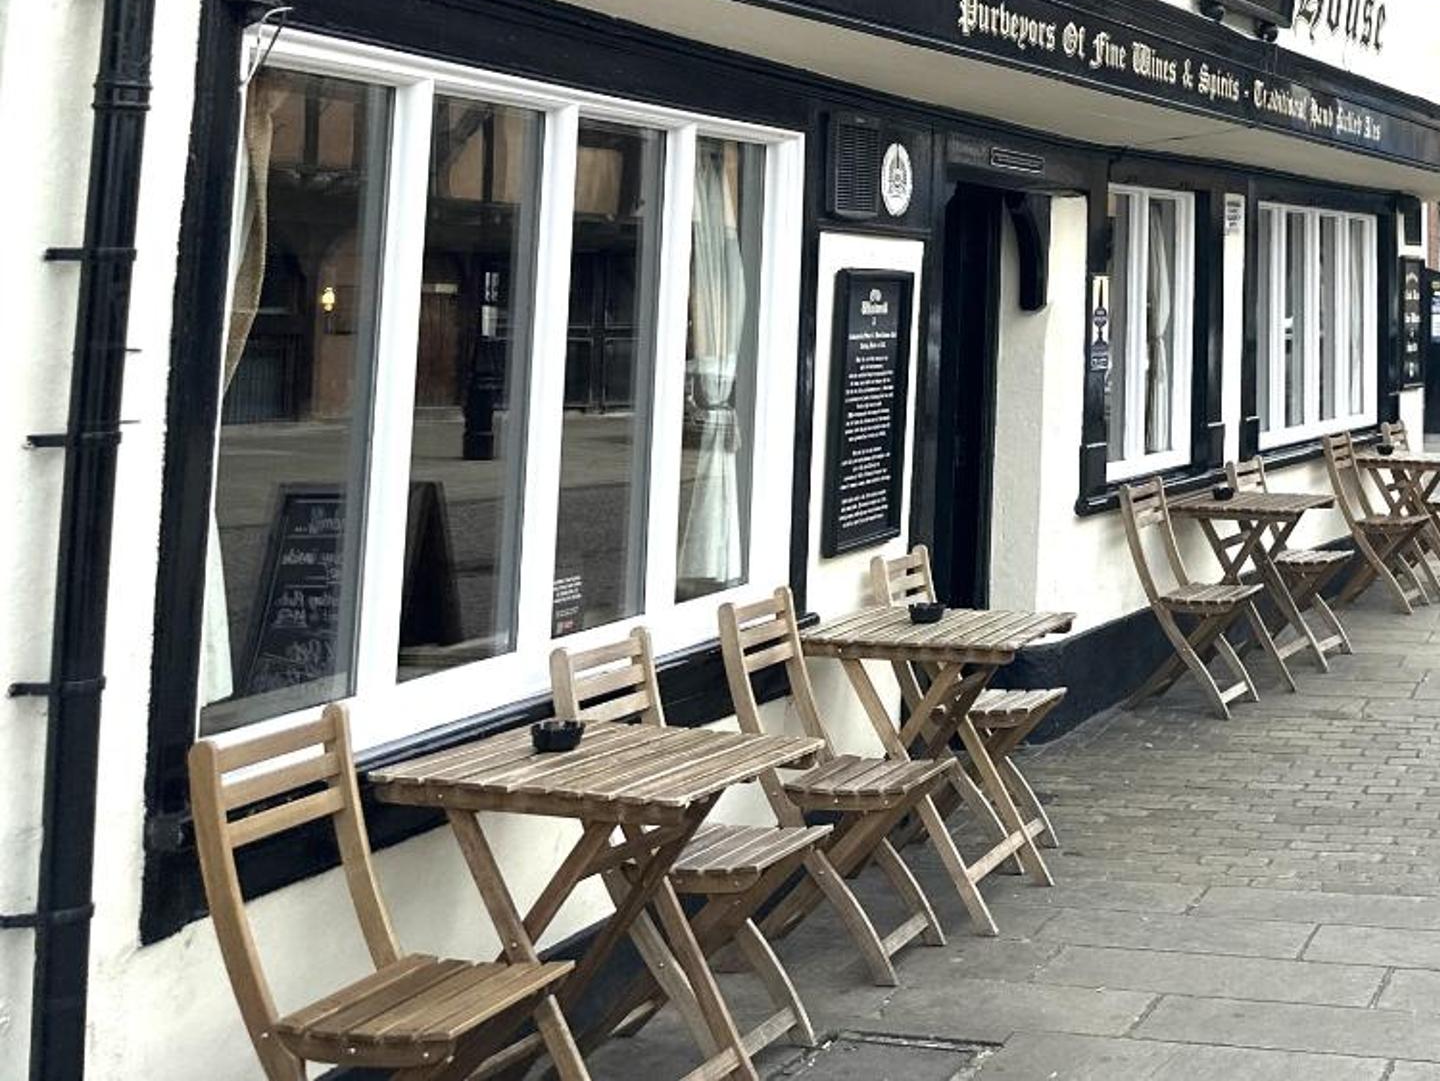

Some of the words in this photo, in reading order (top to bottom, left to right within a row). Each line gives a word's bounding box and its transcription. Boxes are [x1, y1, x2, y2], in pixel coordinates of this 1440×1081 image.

[1062, 21, 1086, 58] Of
[1089, 31, 1127, 69] Fine
[1132, 41, 1177, 86] Wines
[1182, 58, 1194, 89] &
[1198, 62, 1240, 102] Spirits
